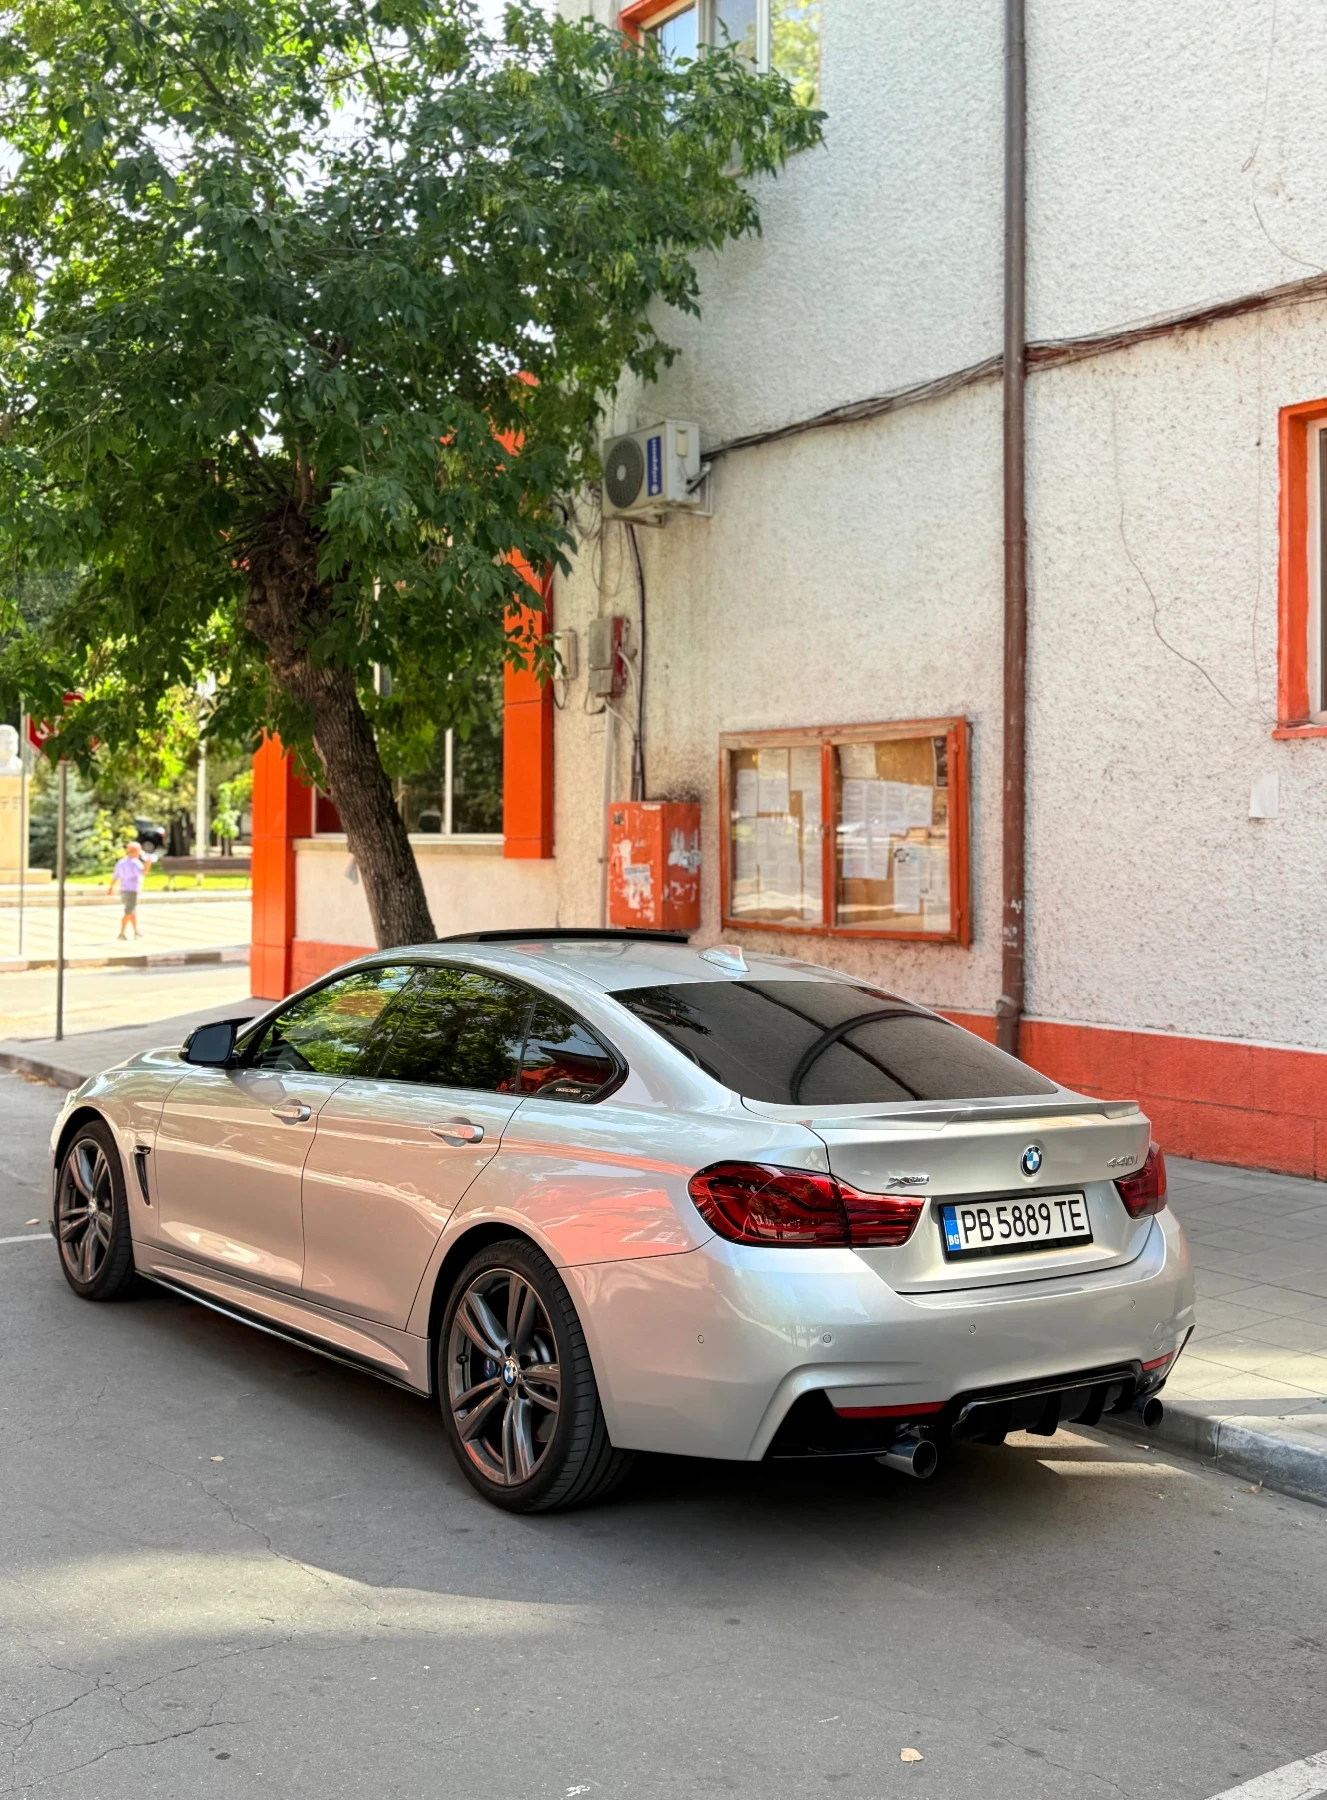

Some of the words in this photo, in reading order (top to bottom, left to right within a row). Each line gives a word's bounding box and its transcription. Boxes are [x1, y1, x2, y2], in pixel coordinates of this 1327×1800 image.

[1106, 1154, 1139, 1168] 440i
[960, 1208, 994, 1244] PB
[996, 1203, 1051, 1239] 5889
[1054, 1199, 1085, 1233] TE
[948, 1234, 960, 1246] BG
